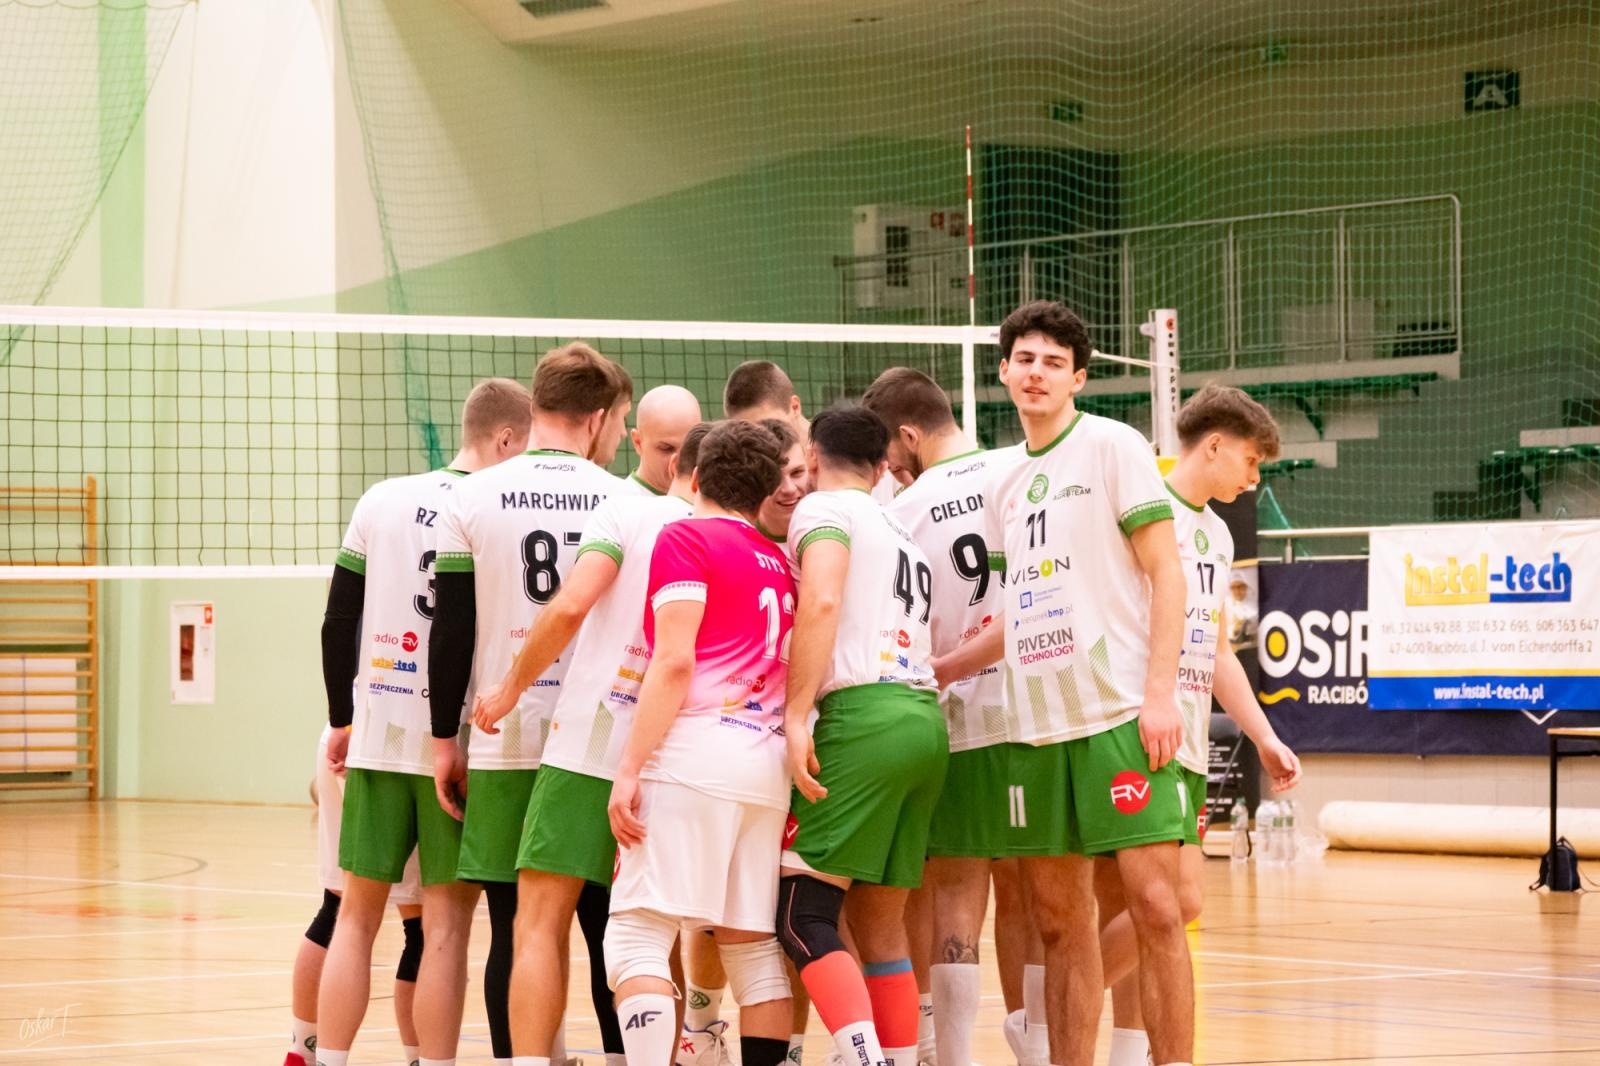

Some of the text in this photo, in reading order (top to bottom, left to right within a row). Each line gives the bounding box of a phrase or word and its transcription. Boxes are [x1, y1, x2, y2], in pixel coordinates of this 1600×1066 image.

[501, 491, 607, 511] MARCHWIA
[1026, 508, 1046, 550] 11
[893, 548, 932, 626] 49
[1197, 562, 1214, 595] 17
[1403, 552, 1573, 606] instal-tech
[1017, 627, 1074, 655] PIVEXIN
[1019, 644, 1075, 666] TECHNOLOGY
[1433, 682, 1545, 704] www.instal-tech.pl
[1009, 786, 1027, 827] 11
[1110, 781, 1150, 804] RV
